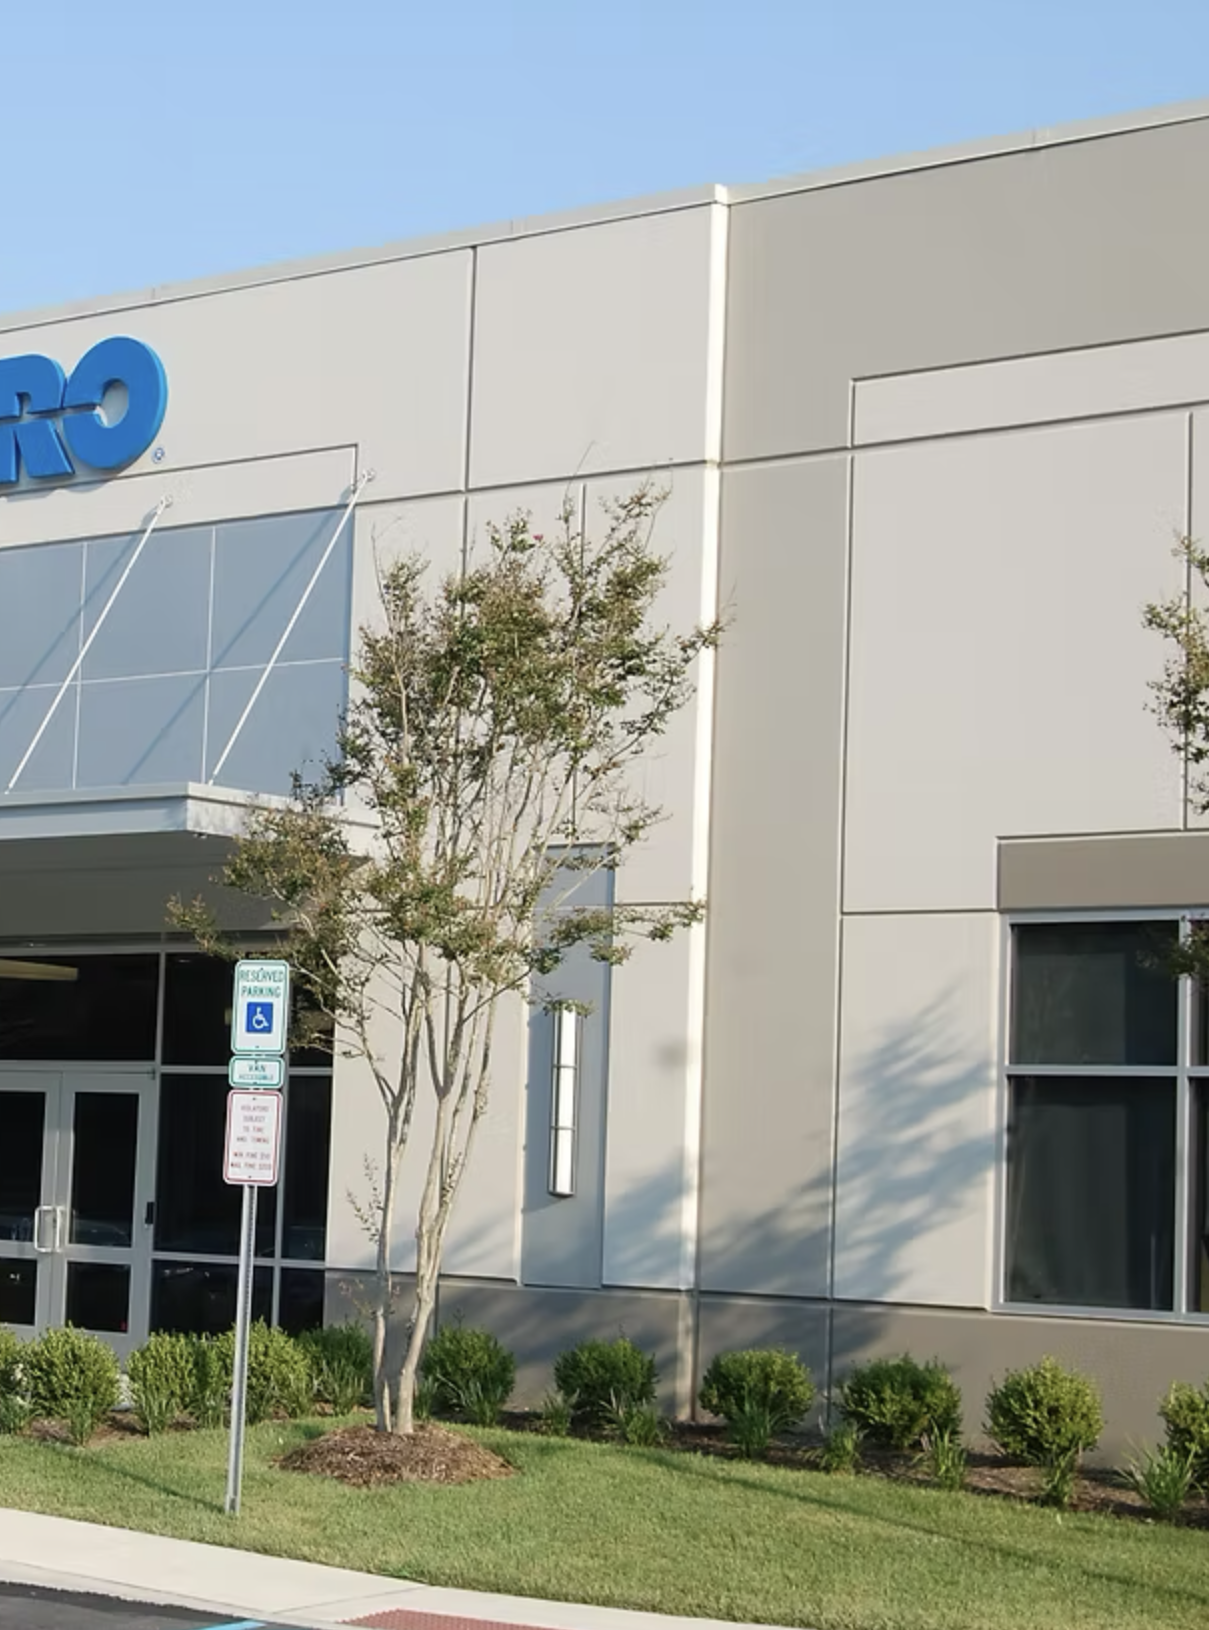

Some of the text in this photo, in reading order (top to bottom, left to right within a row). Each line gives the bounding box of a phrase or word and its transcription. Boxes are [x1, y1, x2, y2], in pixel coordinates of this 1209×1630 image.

[239, 970, 284, 982] RESERVED
[241, 986, 282, 998] PARKING
[248, 1064, 266, 1072] VAN
